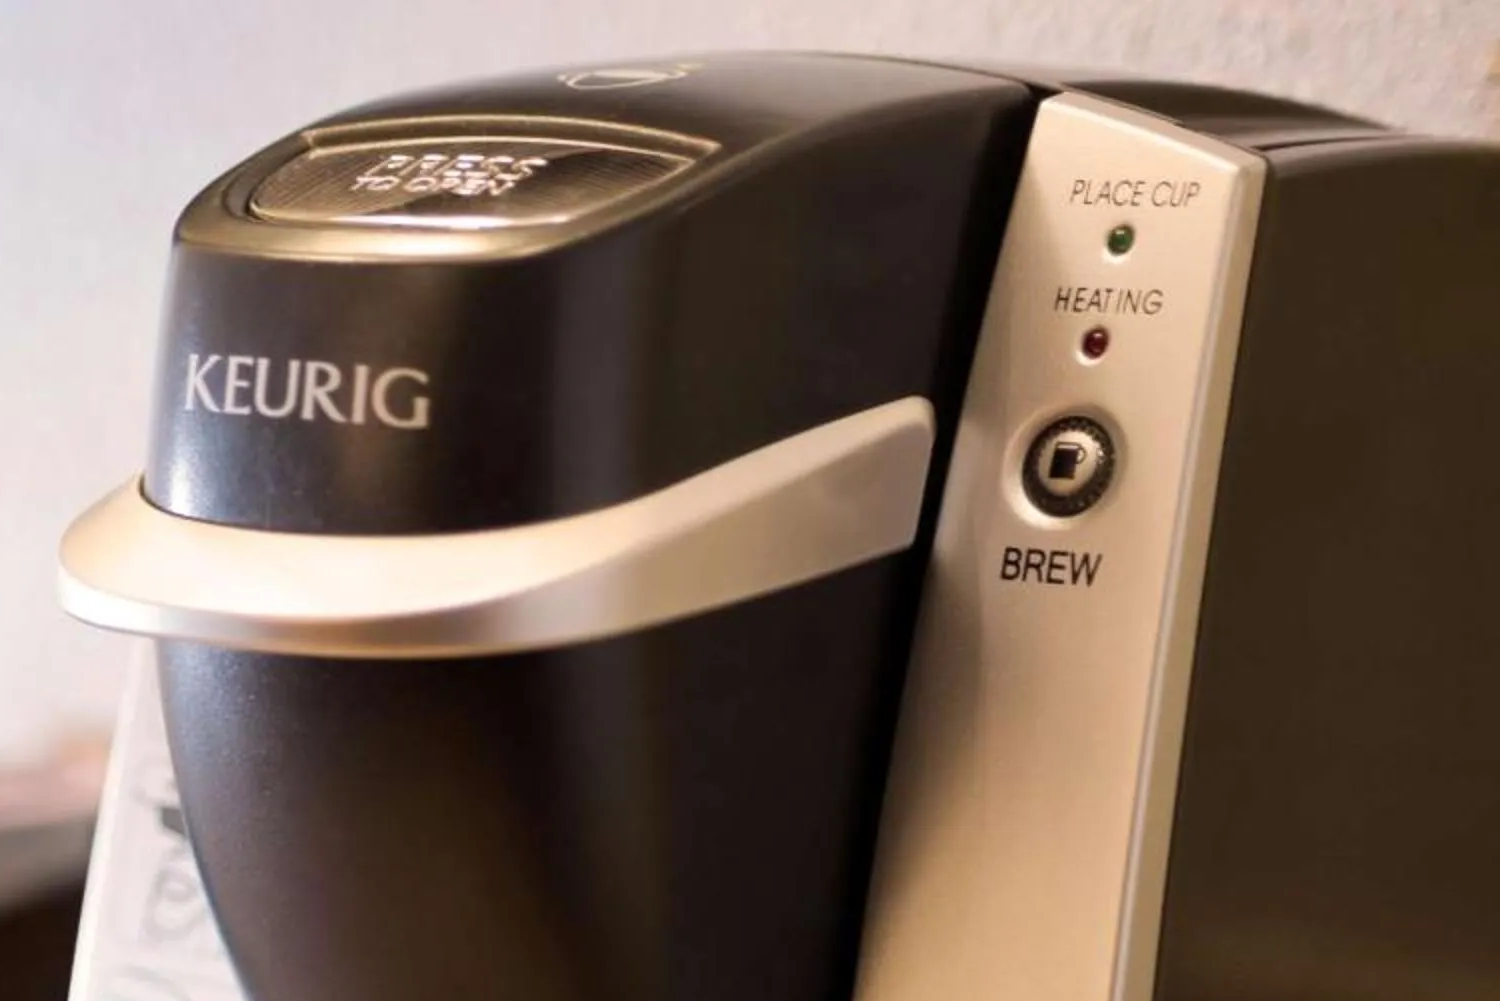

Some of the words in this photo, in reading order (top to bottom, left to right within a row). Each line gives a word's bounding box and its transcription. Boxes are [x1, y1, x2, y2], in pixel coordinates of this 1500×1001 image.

[349, 174, 403, 192] TO
[1068, 178, 1146, 208] PLACE
[1150, 180, 1202, 209] CUP
[1053, 286, 1165, 317] HEATING
[184, 352, 431, 430] KEURIG
[999, 546, 1104, 589] BREW
